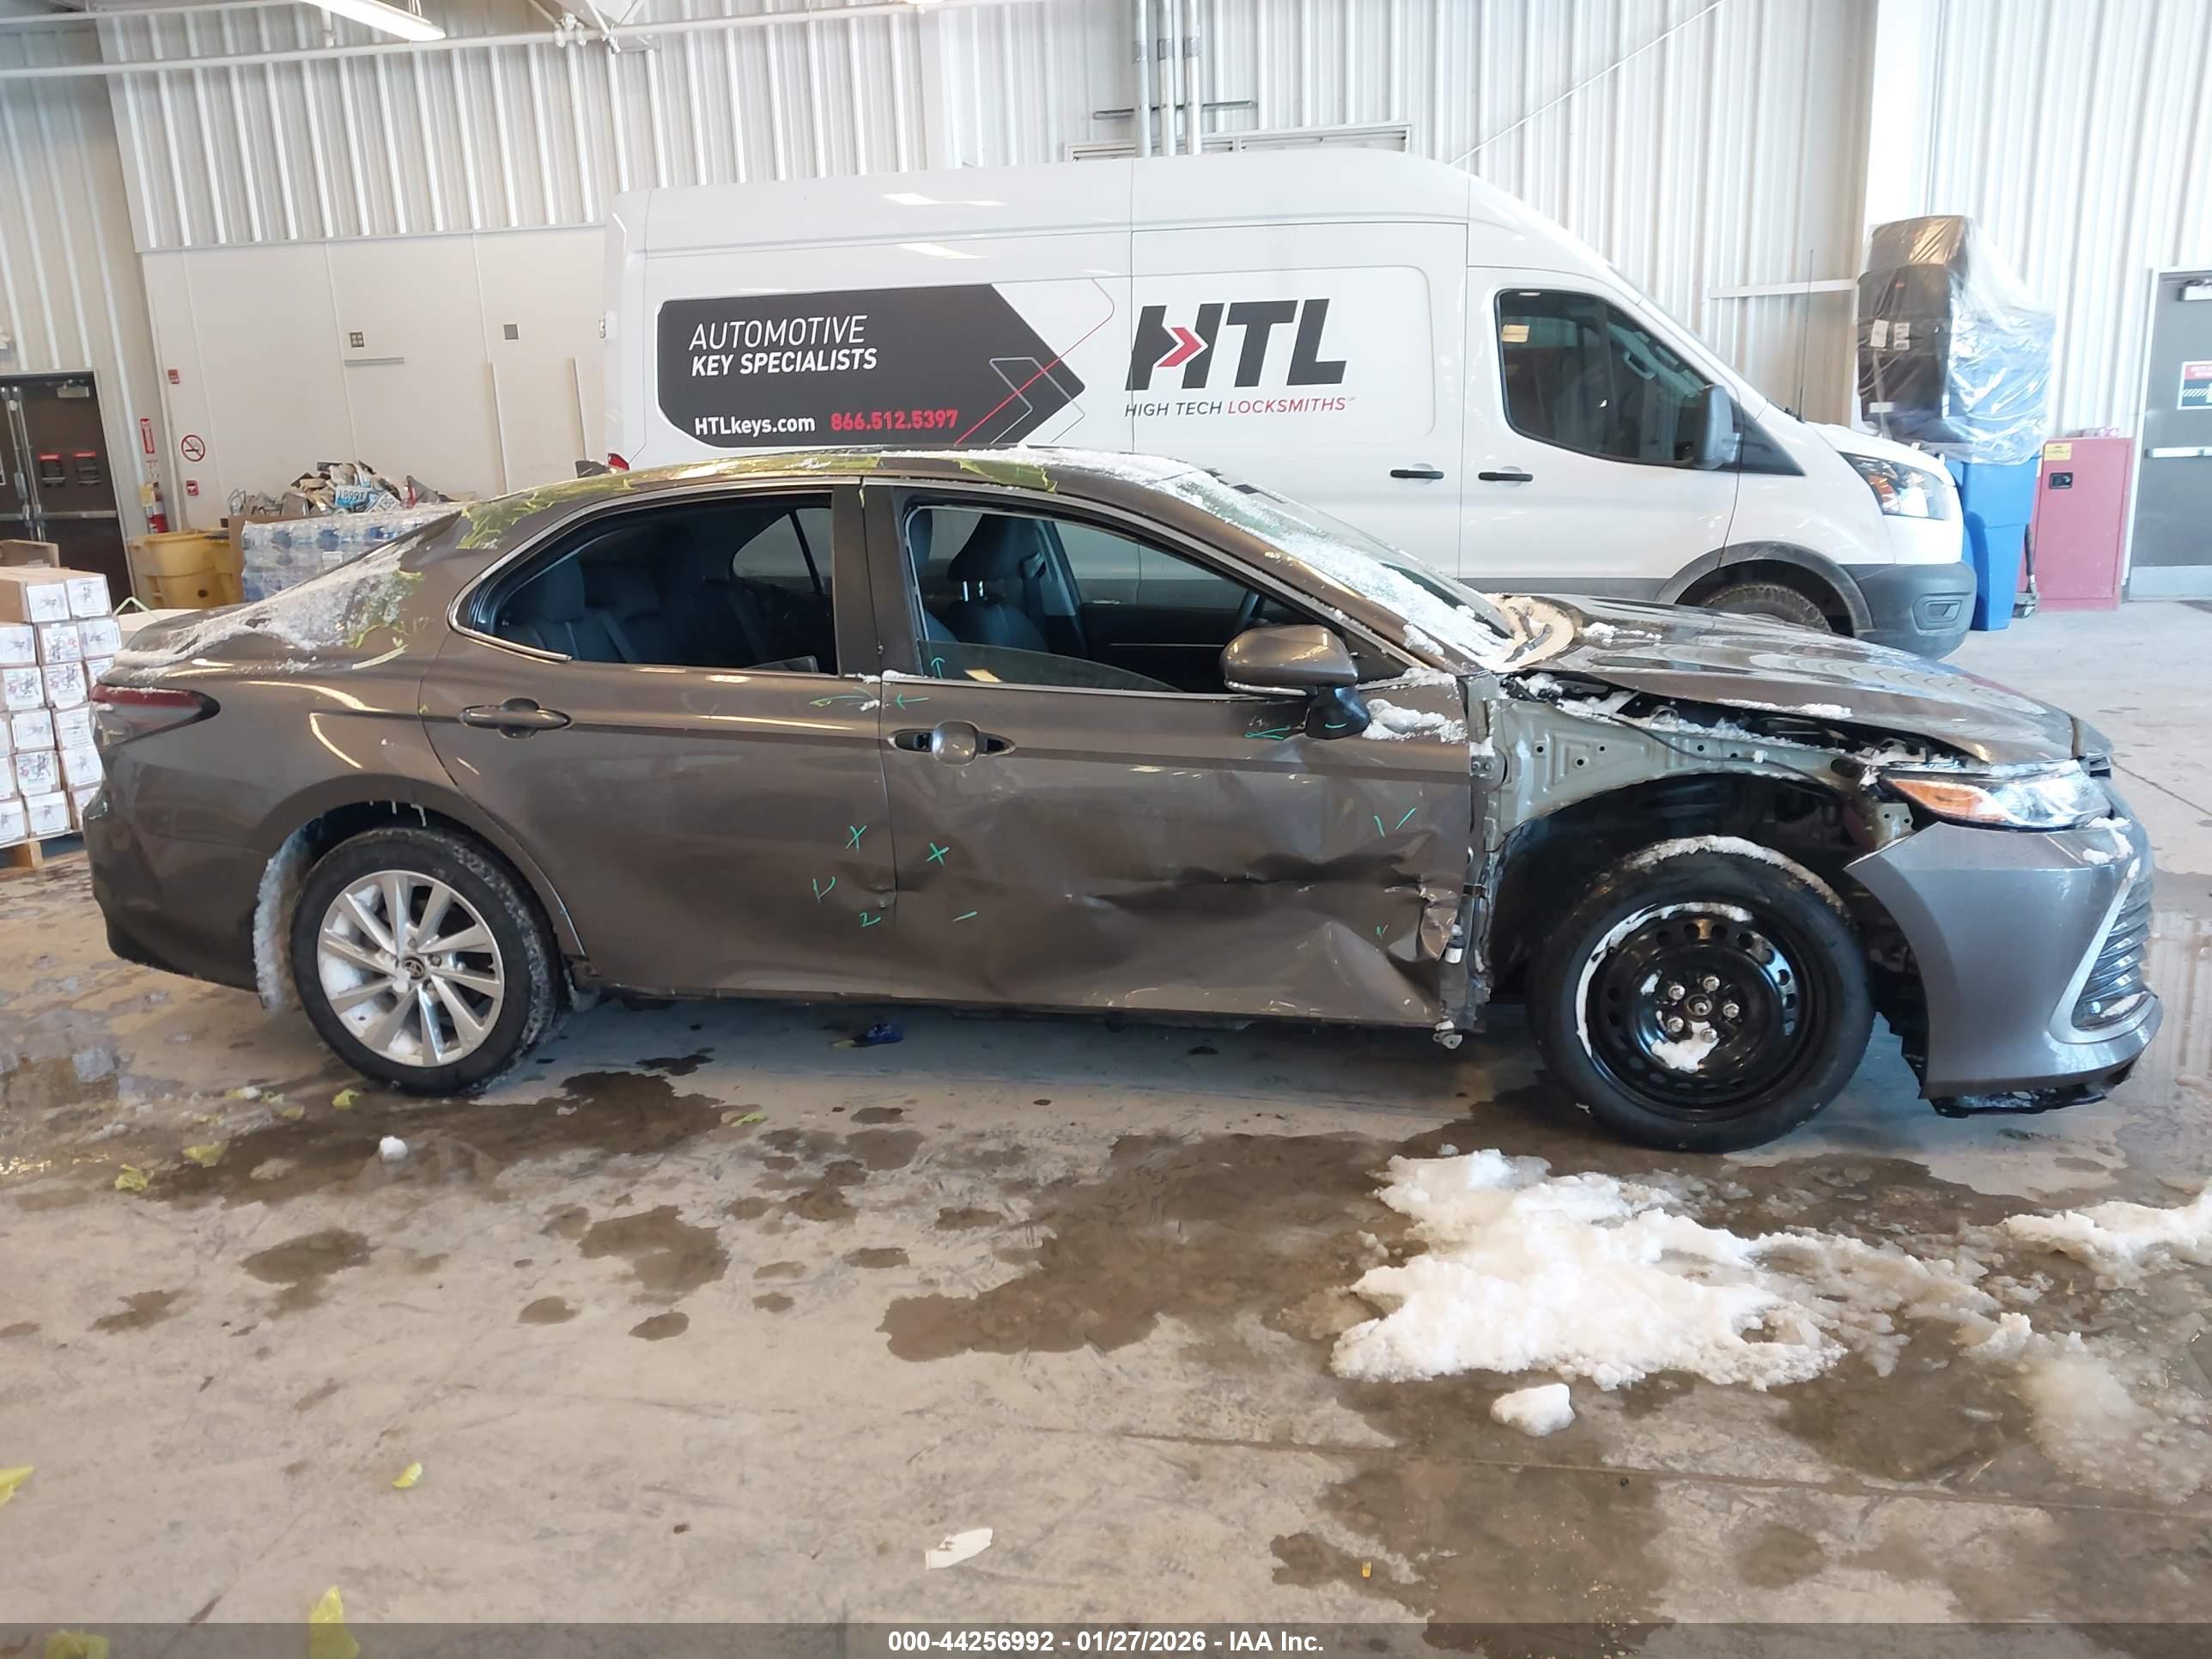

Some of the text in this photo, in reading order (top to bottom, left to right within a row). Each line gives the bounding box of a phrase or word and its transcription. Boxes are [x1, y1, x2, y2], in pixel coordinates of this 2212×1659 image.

[689, 314, 868, 351] AUTOMOTIVE
[1125, 298, 1346, 391] HTL
[691, 347, 878, 377] KEY SPECIALISTS
[1124, 396, 1346, 417] HIGH TECH LOCKSMITHS
[694, 409, 958, 439] HTLkeys.com 866.512.5397
